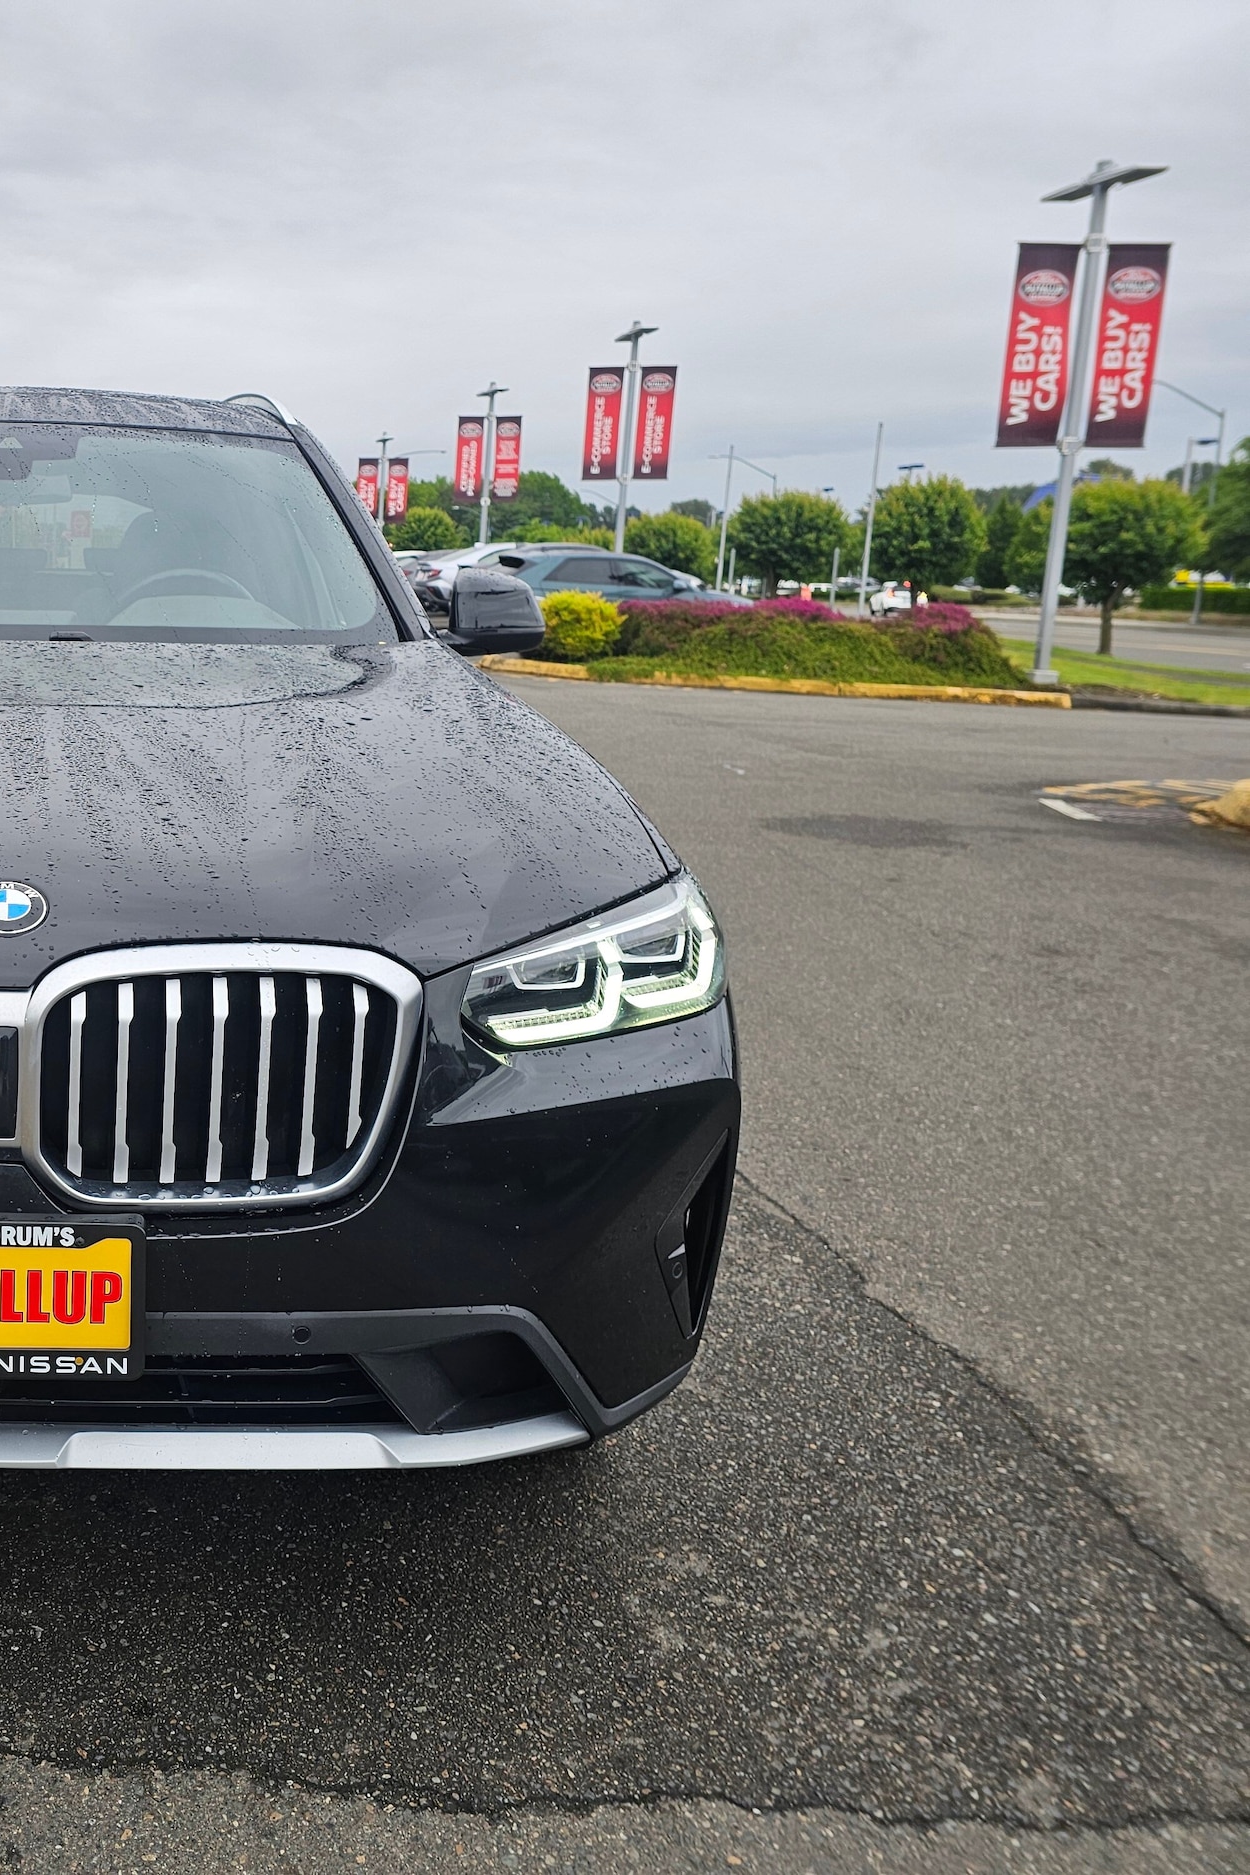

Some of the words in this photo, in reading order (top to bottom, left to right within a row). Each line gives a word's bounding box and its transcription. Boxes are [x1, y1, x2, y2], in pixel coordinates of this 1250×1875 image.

[1012, 311, 1041, 372] BUY
[1033, 325, 1063, 412] CARS!
[1102, 308, 1130, 370] BUY
[1120, 322, 1153, 409] CARS!
[1005, 378, 1033, 426] WE
[1094, 375, 1121, 423] WE
[590, 396, 605, 474] E-COMMERCE
[601, 416, 613, 455] STORE
[641, 395, 657, 474] E-COMMERCE
[652, 415, 665, 454] STORE
